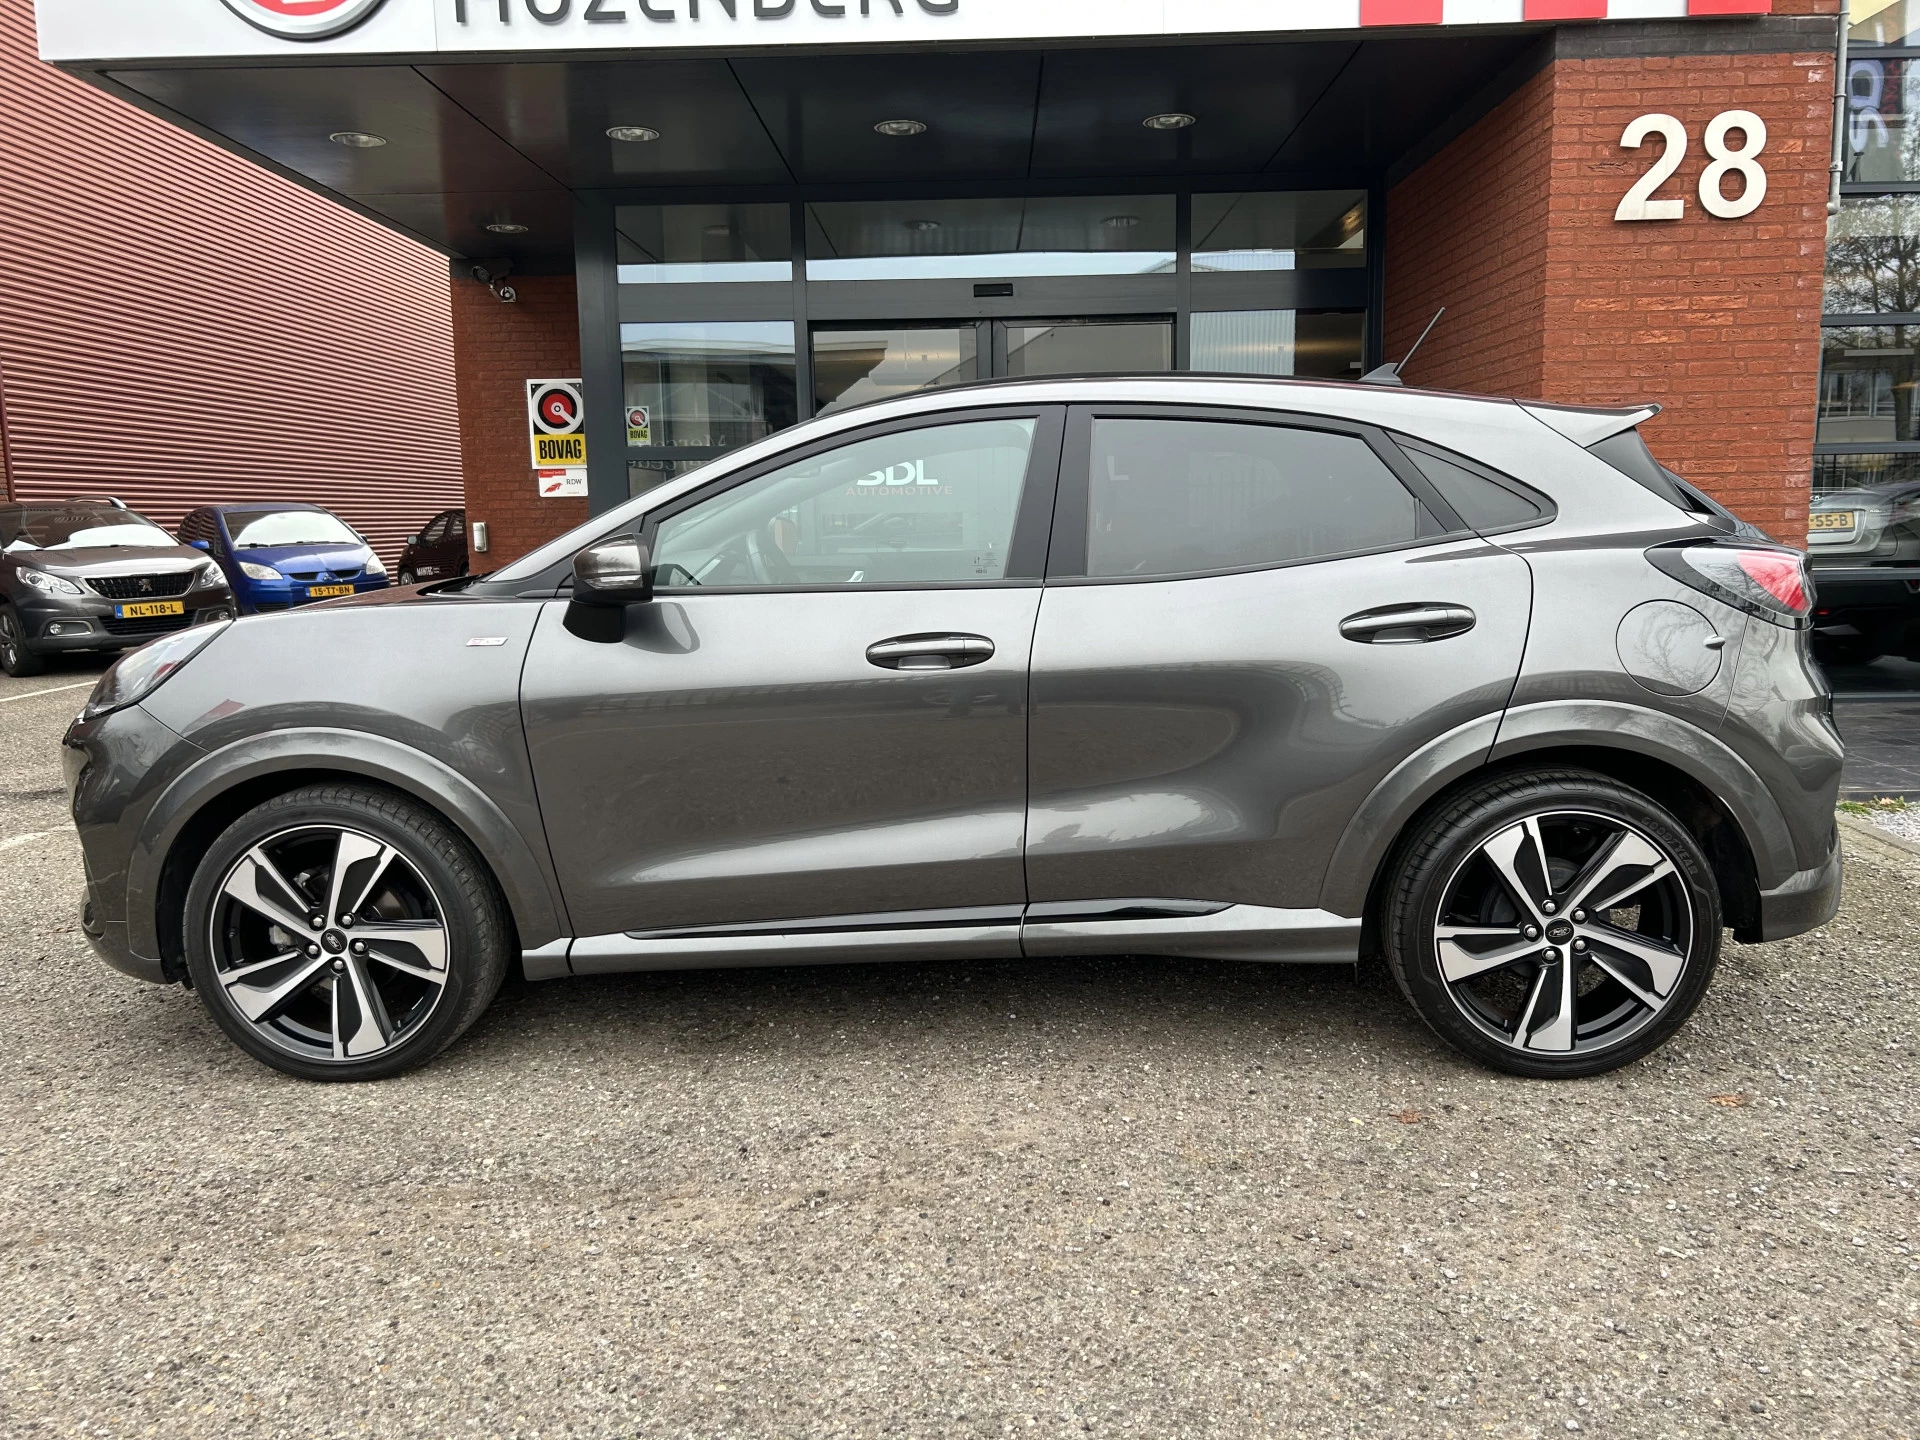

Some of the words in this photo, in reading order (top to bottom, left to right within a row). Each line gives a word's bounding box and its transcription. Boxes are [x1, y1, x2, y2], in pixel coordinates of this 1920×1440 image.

[1614, 110, 1767, 220] 28
[629, 430, 648, 439] BOVAG
[539, 439, 582, 459] BOVAG
[846, 485, 953, 496] AUTOMOTIVE
[313, 586, 350, 596] 15-TT-BN
[129, 603, 177, 617] NL-118-L
